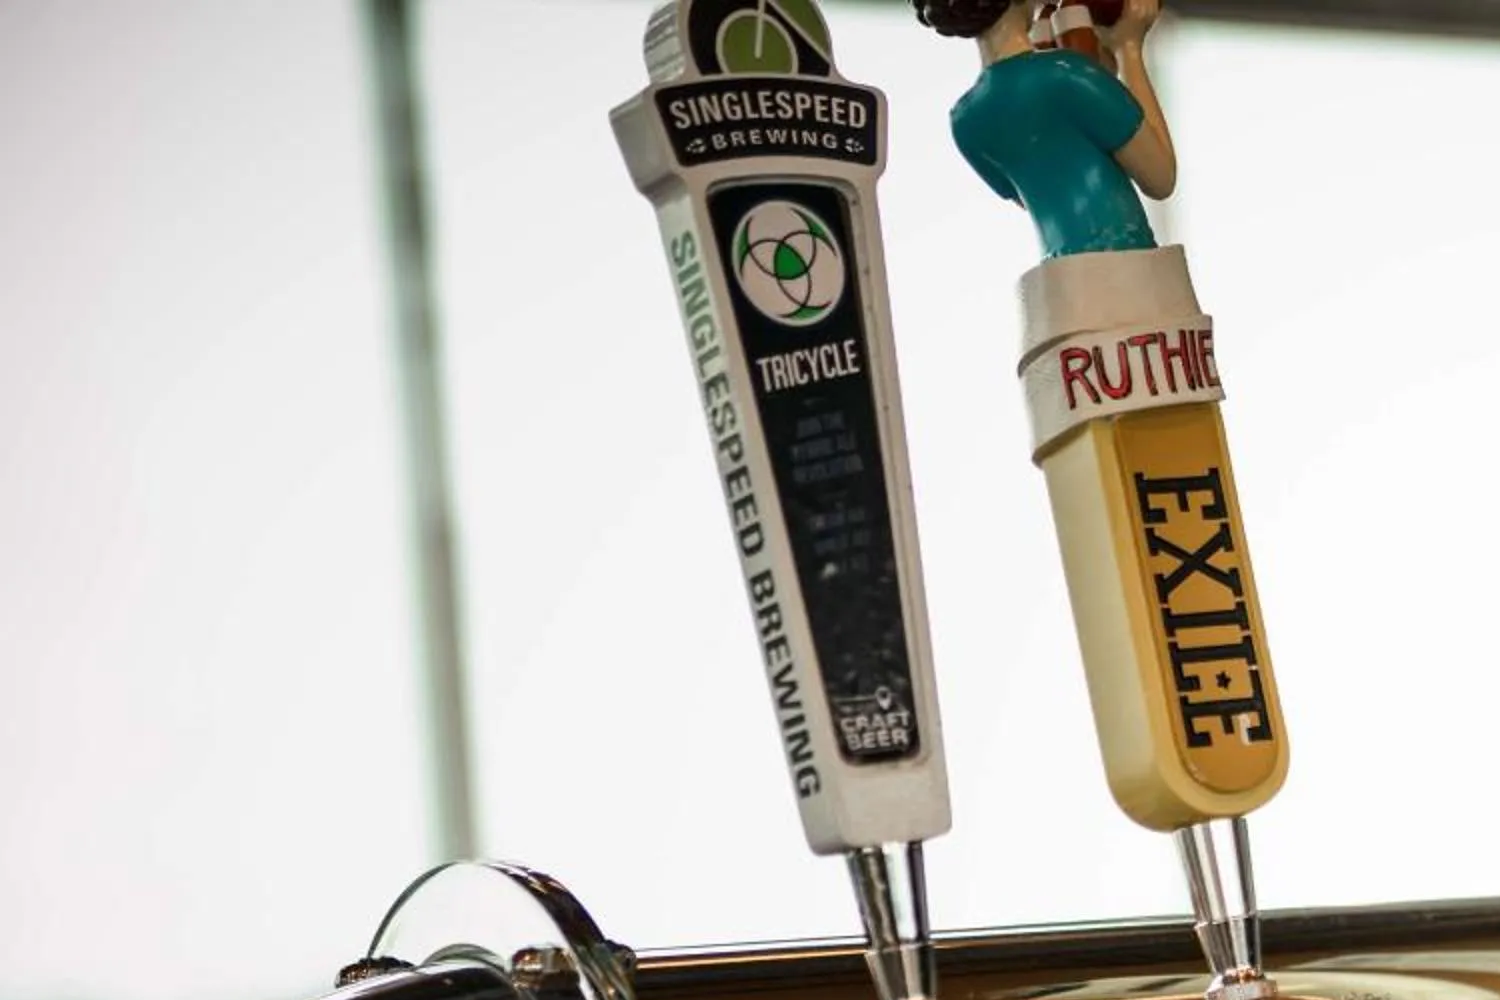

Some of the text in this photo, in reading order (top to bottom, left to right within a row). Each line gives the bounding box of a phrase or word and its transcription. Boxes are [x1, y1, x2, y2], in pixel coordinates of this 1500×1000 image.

[669, 90, 867, 129] SINGLESPEED
[712, 128, 837, 150] BREWING
[756, 339, 860, 392] TRICYCLE
[1060, 329, 1221, 410] RUTHIE
[671, 229, 821, 800] SINGLESPEED BREWING
[1133, 466, 1273, 749] EXILE
[840, 709, 910, 733] CRAFT
[846, 728, 909, 751] BEER
